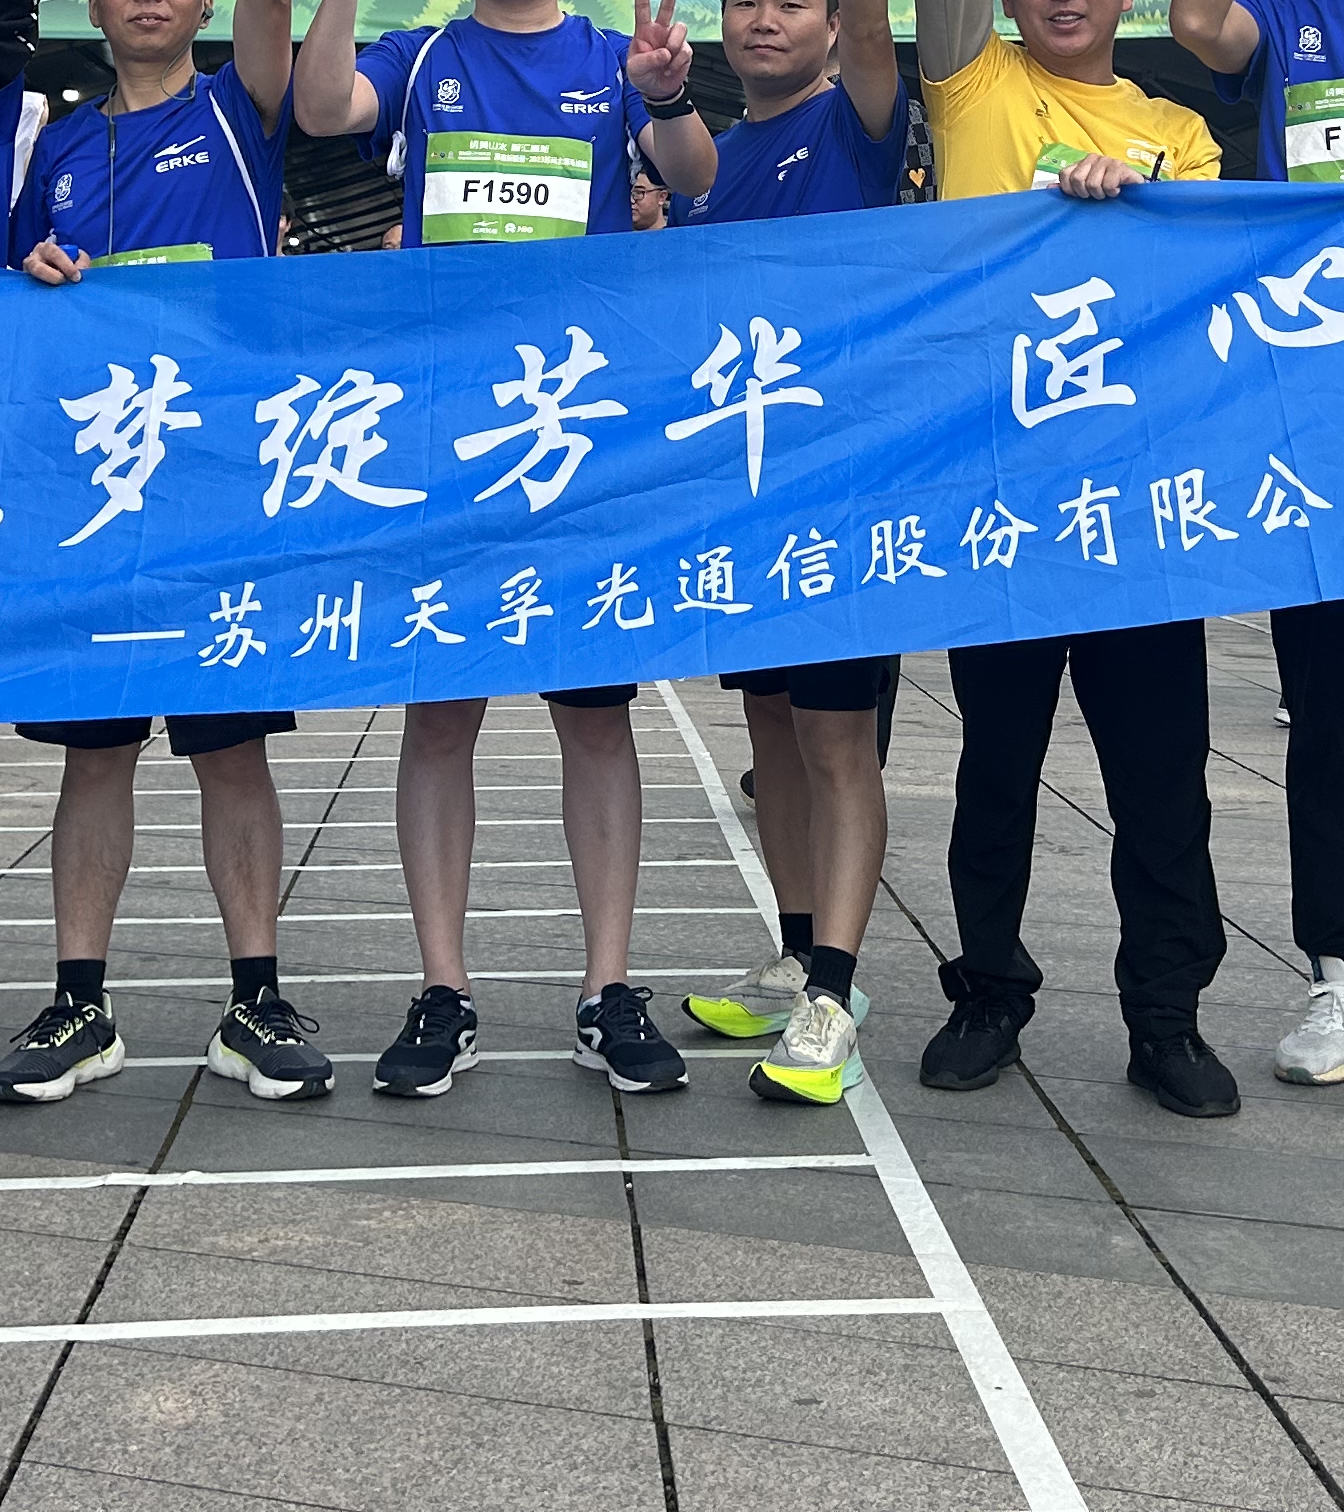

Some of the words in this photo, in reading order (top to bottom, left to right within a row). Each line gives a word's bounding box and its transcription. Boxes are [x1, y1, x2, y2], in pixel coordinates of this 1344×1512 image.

[560, 102, 610, 114] ERKE
[156, 151, 210, 173] ERKE
[463, 179, 549, 206] F1590
